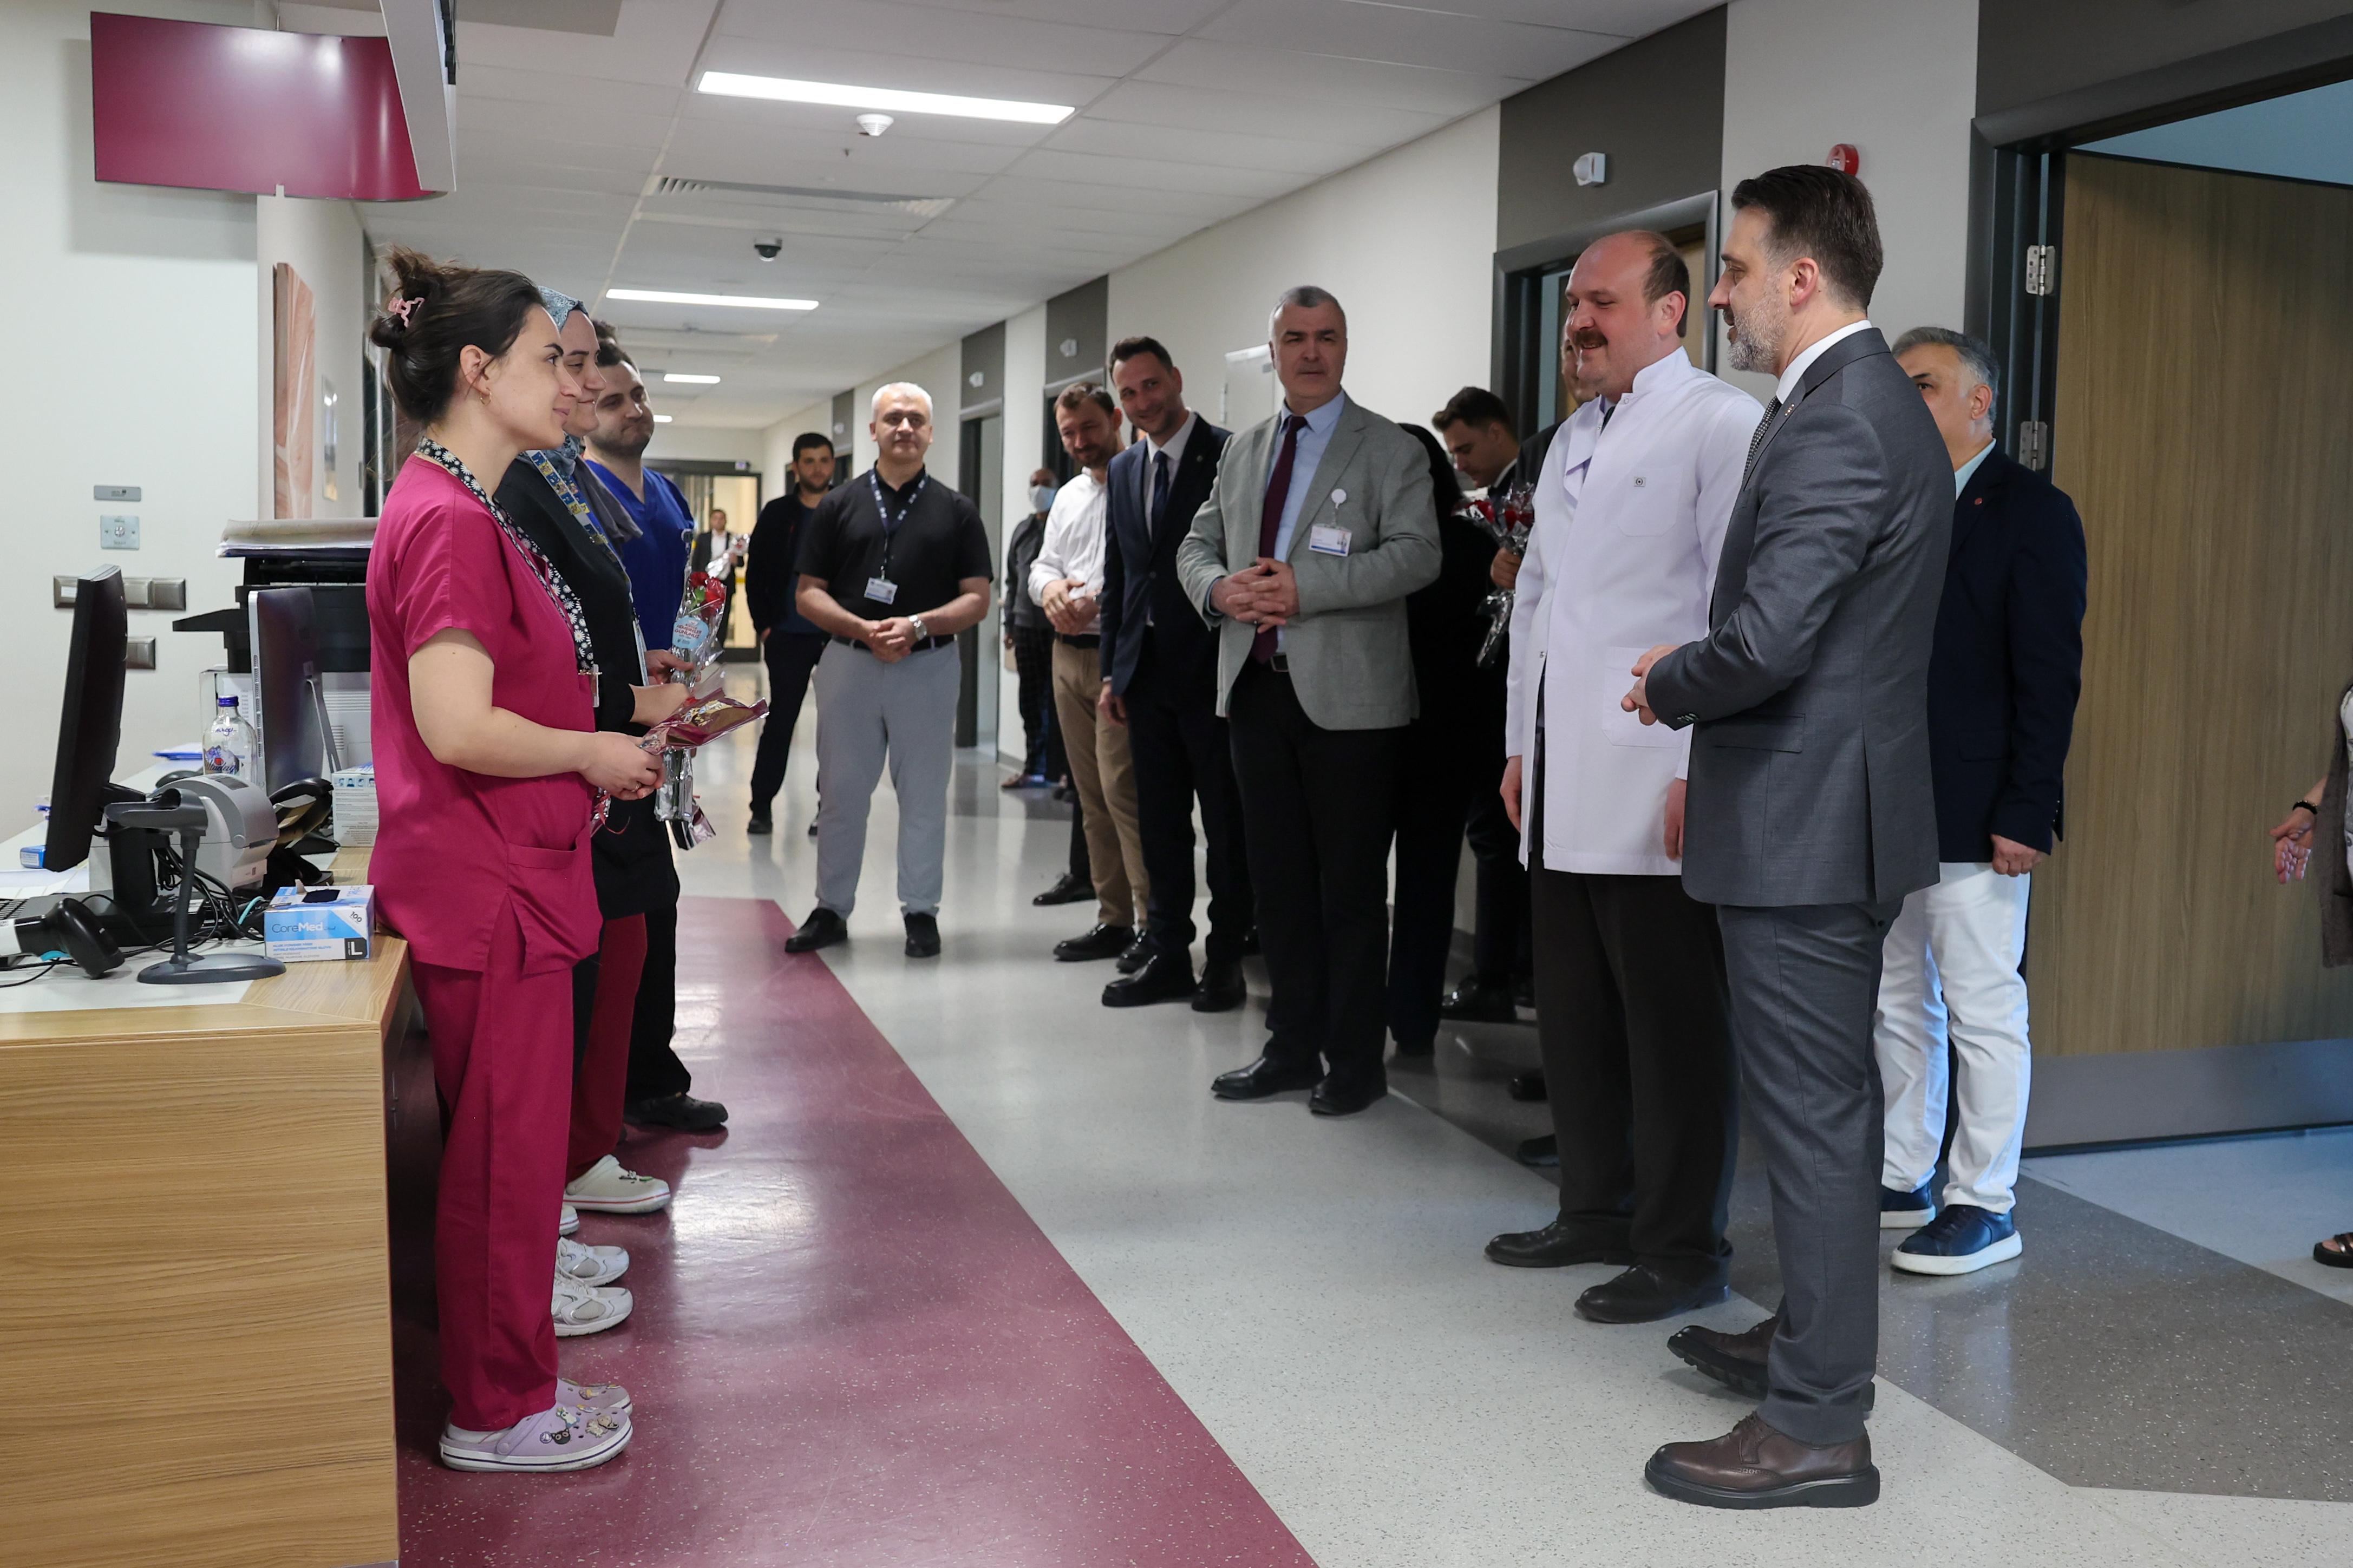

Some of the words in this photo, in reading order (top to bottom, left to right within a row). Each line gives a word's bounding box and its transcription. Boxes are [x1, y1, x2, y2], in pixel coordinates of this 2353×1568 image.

[350, 911, 362, 922] 100
[272, 922, 323, 933] CoreMed
[350, 941, 363, 955] L
